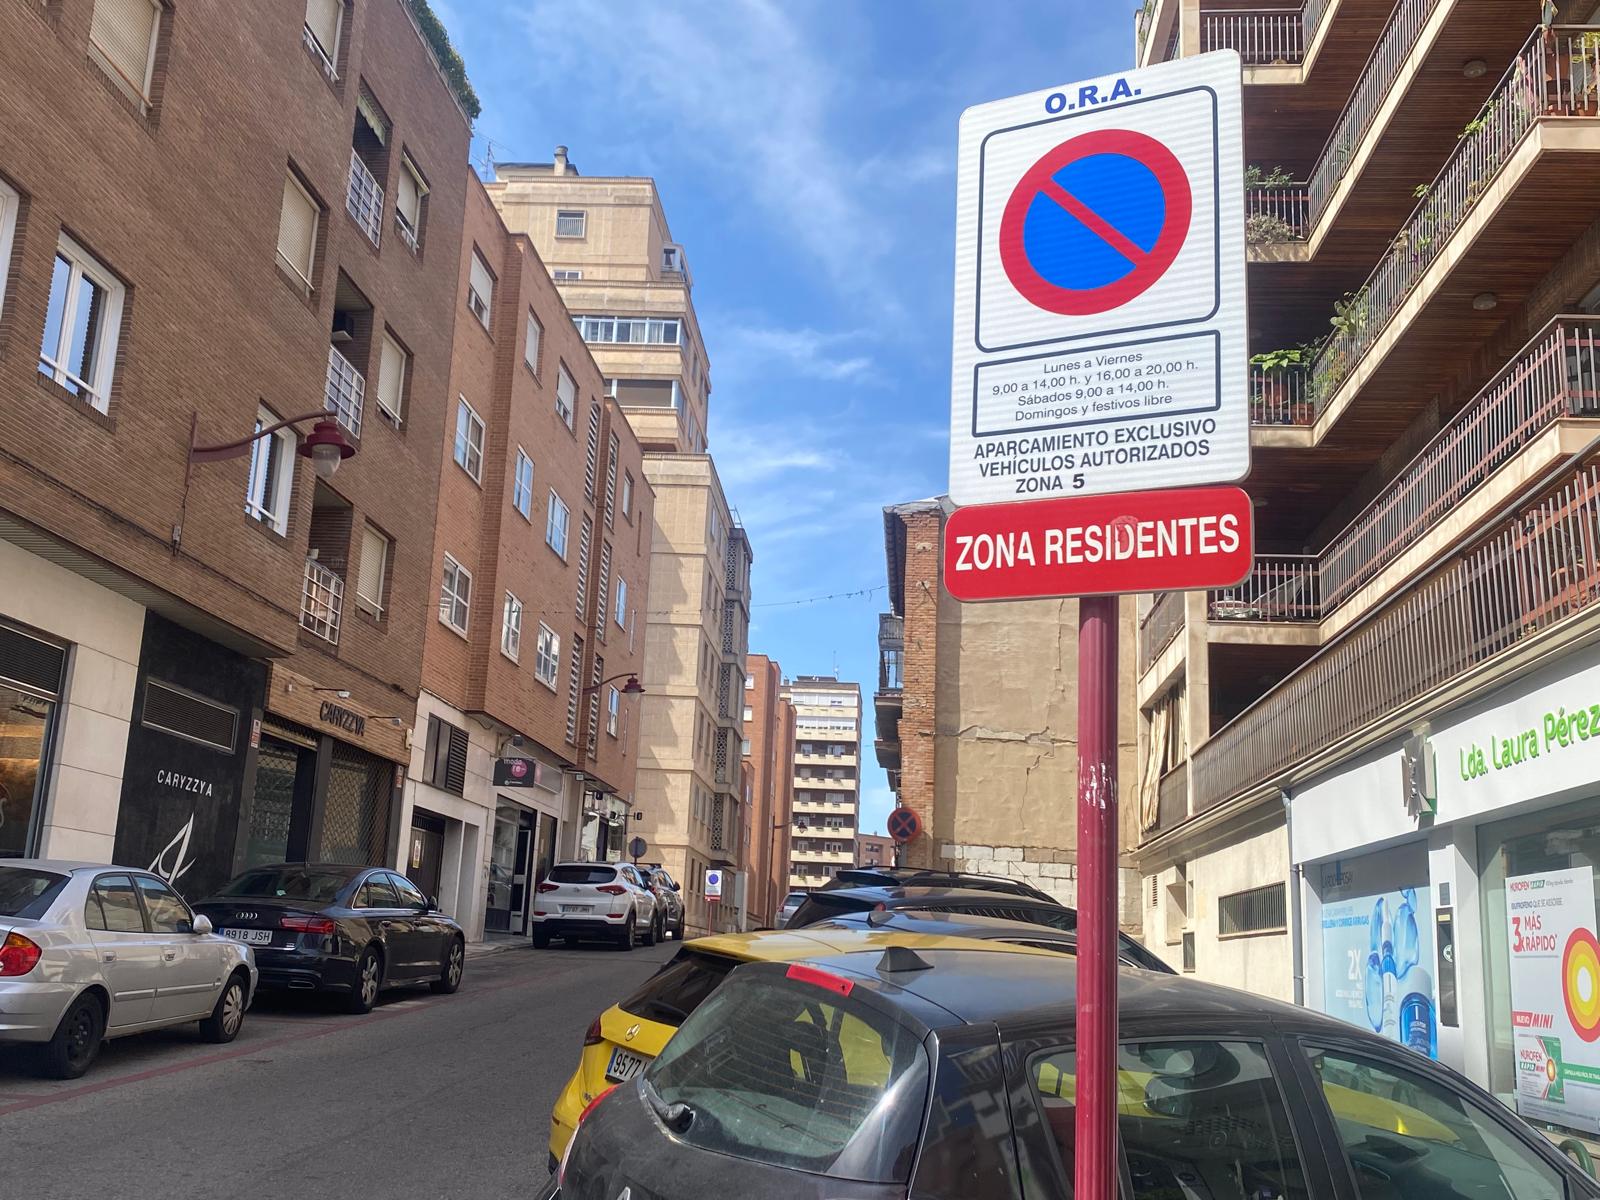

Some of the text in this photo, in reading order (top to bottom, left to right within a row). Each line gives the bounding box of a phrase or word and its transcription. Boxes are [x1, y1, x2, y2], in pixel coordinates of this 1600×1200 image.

[1045, 78, 1141, 114] O.R.A.
[1021, 383, 1029, 391] a
[1070, 375, 1081, 385] h.
[1085, 375, 1092, 386] y
[1135, 368, 1142, 377] a
[1186, 360, 1199, 370] h.
[1043, 353, 1143, 374] Lunes a Viernes
[1018, 391, 1073, 407] Sábados
[1106, 387, 1114, 395] a
[1157, 378, 1169, 389] h.
[1015, 395, 1173, 422] Domingos y festivos libre
[974, 418, 1216, 459] APARCAMIENTO EXCLUSIVO
[979, 439, 1210, 478] VEHÍCULOS AUTORIZADOS
[1015, 473, 1085, 494] ZONA 5
[955, 514, 1240, 571] ZONA RESIDENTES
[320, 700, 366, 737] CARYZZYA
[1460, 704, 1600, 781] Lda. Laura Pérez
[157, 769, 213, 797] CARYZZYA
[1524, 911, 1542, 931] MÁS
[252, 931, 271, 941] JSH
[1532, 1013, 1554, 1029] MINI
[613, 1053, 642, 1079] 9577
